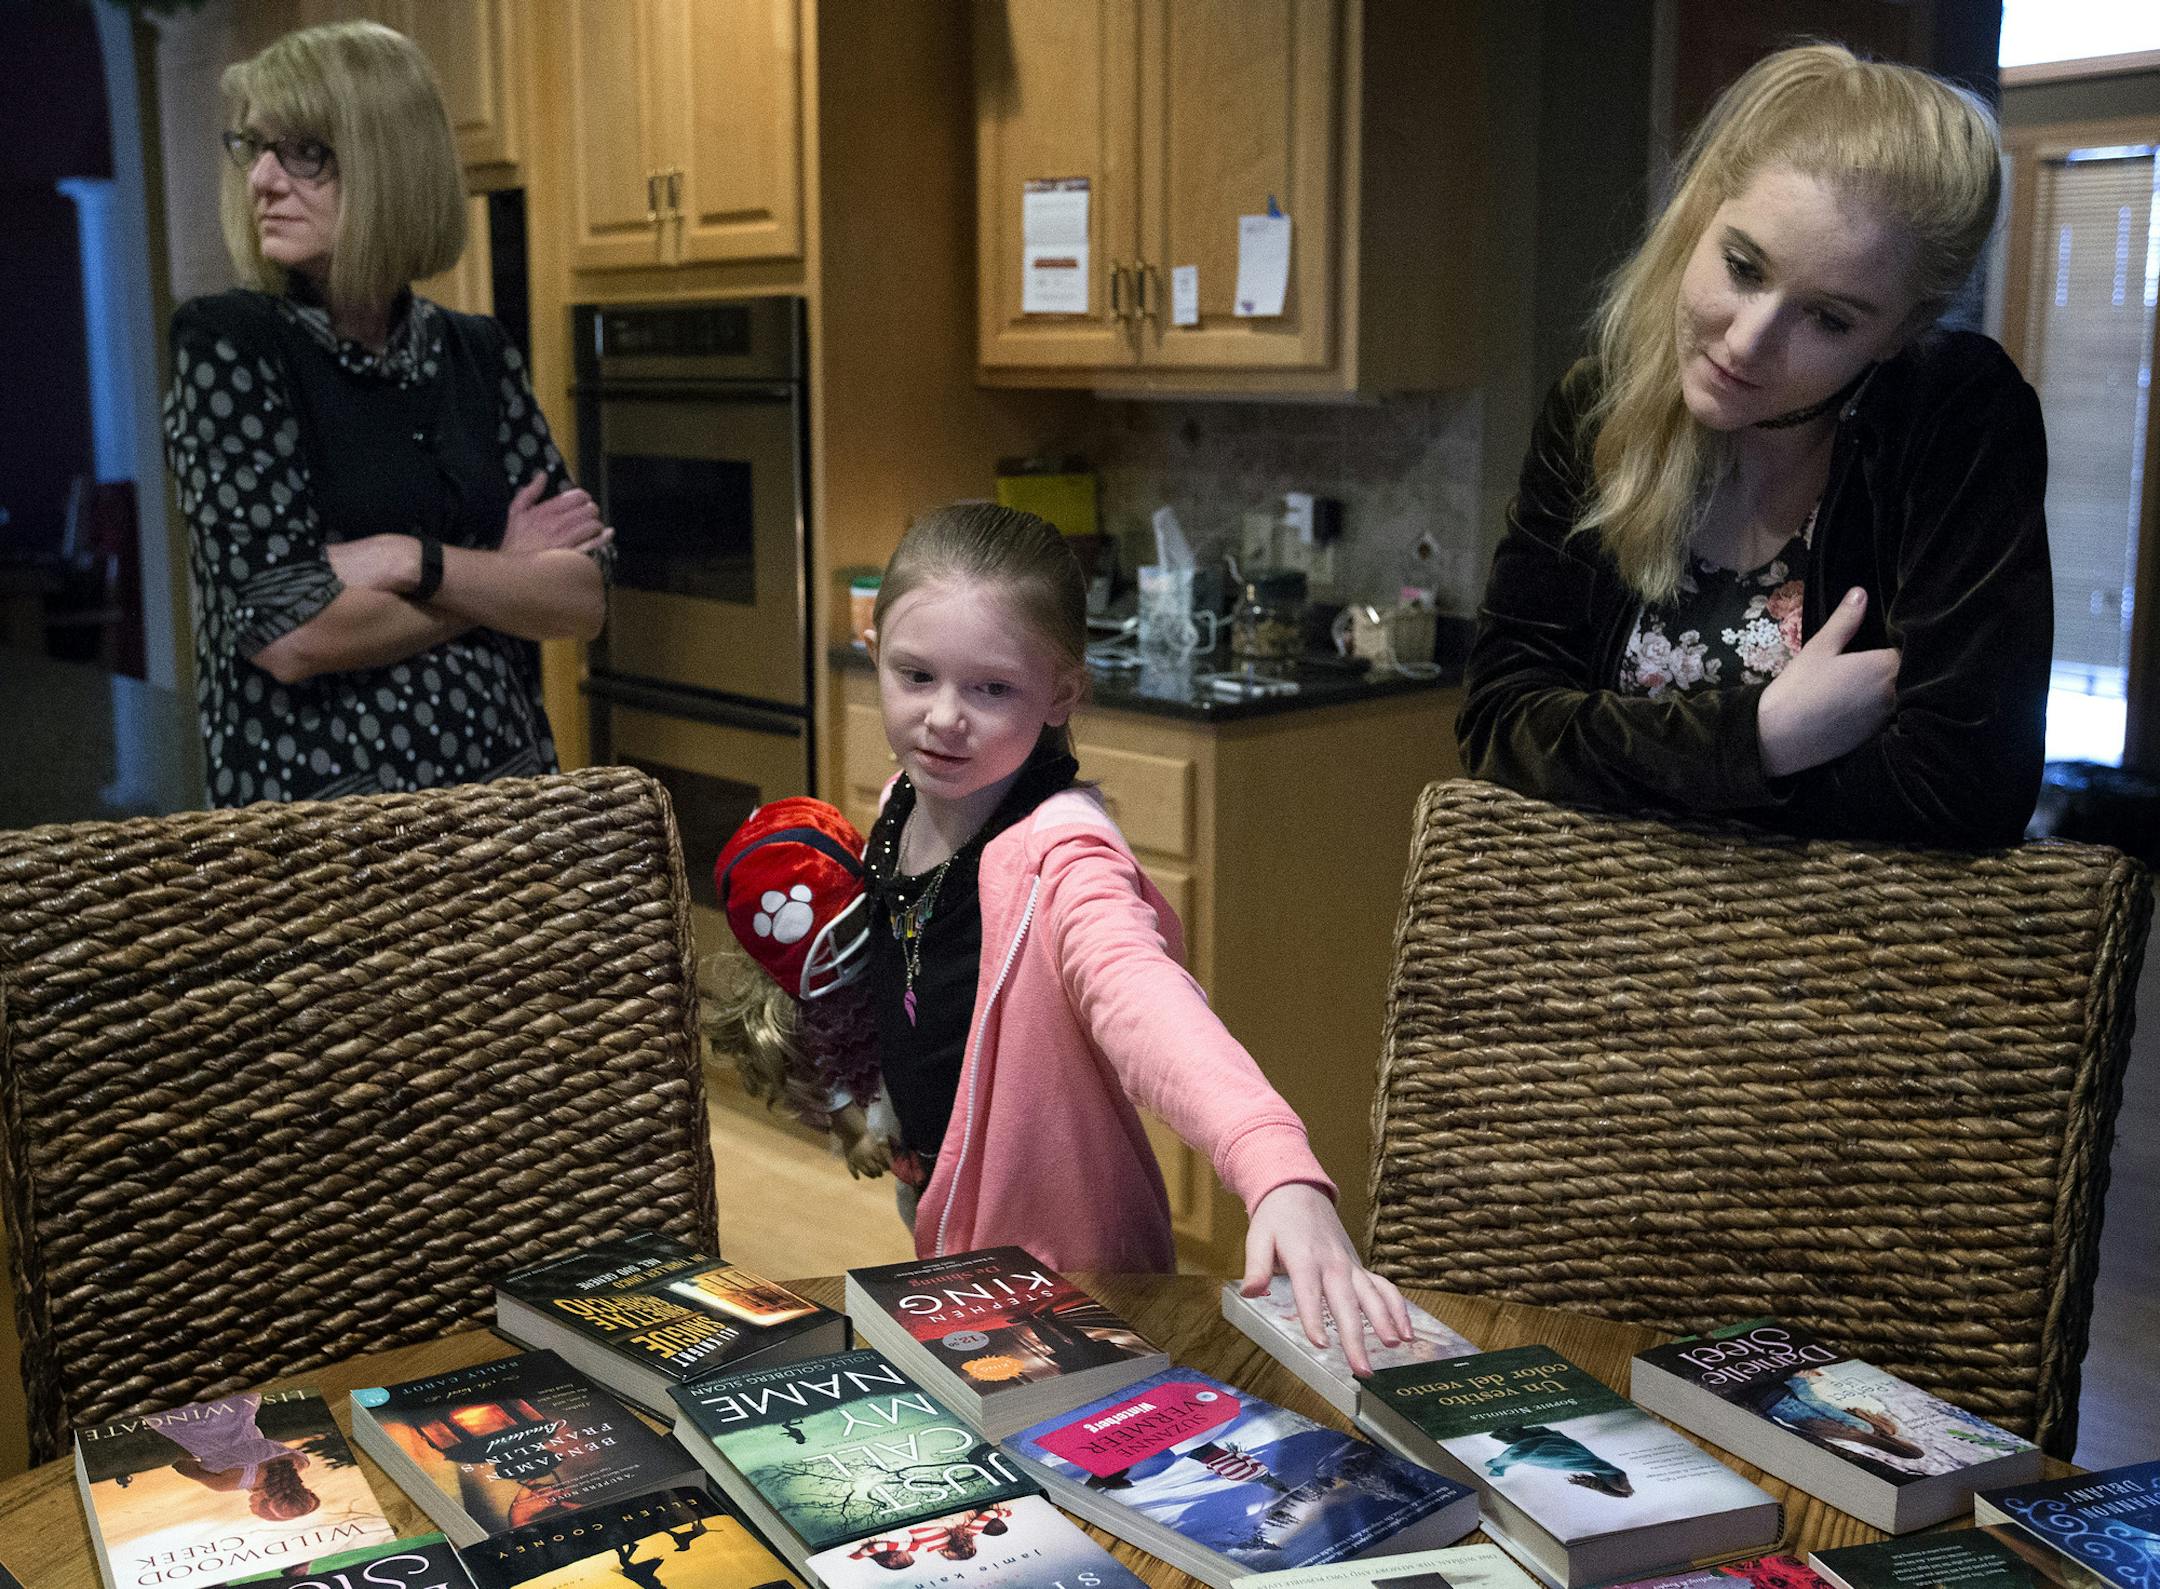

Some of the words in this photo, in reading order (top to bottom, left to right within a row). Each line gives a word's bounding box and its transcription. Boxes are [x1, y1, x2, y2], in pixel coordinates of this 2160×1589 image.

[637, 1256, 662, 1269] NEL
[975, 1265, 1000, 1275] De
[899, 1270, 1054, 1314] KING
[907, 1271, 974, 1287] Shining
[929, 1290, 1053, 1324] STEPHEN
[629, 1316, 729, 1359] SANGUE
[1678, 1326, 1793, 1370] Steel
[670, 1336, 717, 1368] KNIGHT
[831, 1354, 876, 1368] HOLLY
[1701, 1343, 1838, 1387] Danielle
[467, 1361, 519, 1377] SALLY
[745, 1364, 826, 1385] GOLDBERG
[1465, 1369, 1503, 1392] del
[1510, 1362, 1569, 1381] color
[242, 1390, 305, 1407] LISA
[401, 1376, 458, 1395] CABOT
[690, 1380, 743, 1396] SLOAN
[701, 1364, 906, 1423] NAME
[1394, 1378, 1460, 1400] vento
[1438, 1384, 1520, 1409] vestito
[1525, 1376, 1569, 1396] Un
[838, 1392, 939, 1437] MY
[1082, 1401, 1157, 1434] Winterberg
[1469, 1405, 1532, 1422] NICHOLLS
[1534, 1397, 1578, 1414] SOPHIE
[84, 1404, 234, 1441] WINGATE
[485, 1419, 566, 1453] Bastard
[1078, 1398, 1206, 1454] VERMEER
[460, 1423, 613, 1473] FRANKLIN'S
[1112, 1414, 1208, 1460] SUZANNE
[484, 1437, 617, 1482] BENJAMIN
[802, 1426, 973, 1479] CALL
[878, 1452, 1018, 1514] JUST
[2064, 1480, 2145, 1503] DELANY
[622, 1497, 698, 1522] ELLEN
[135, 1536, 244, 1570] CREEK
[138, 1523, 364, 1586] WILDWOOD
[498, 1523, 604, 1560] COONEY
[979, 1549, 1042, 1573] jamie
[914, 1572, 965, 1589] kain
